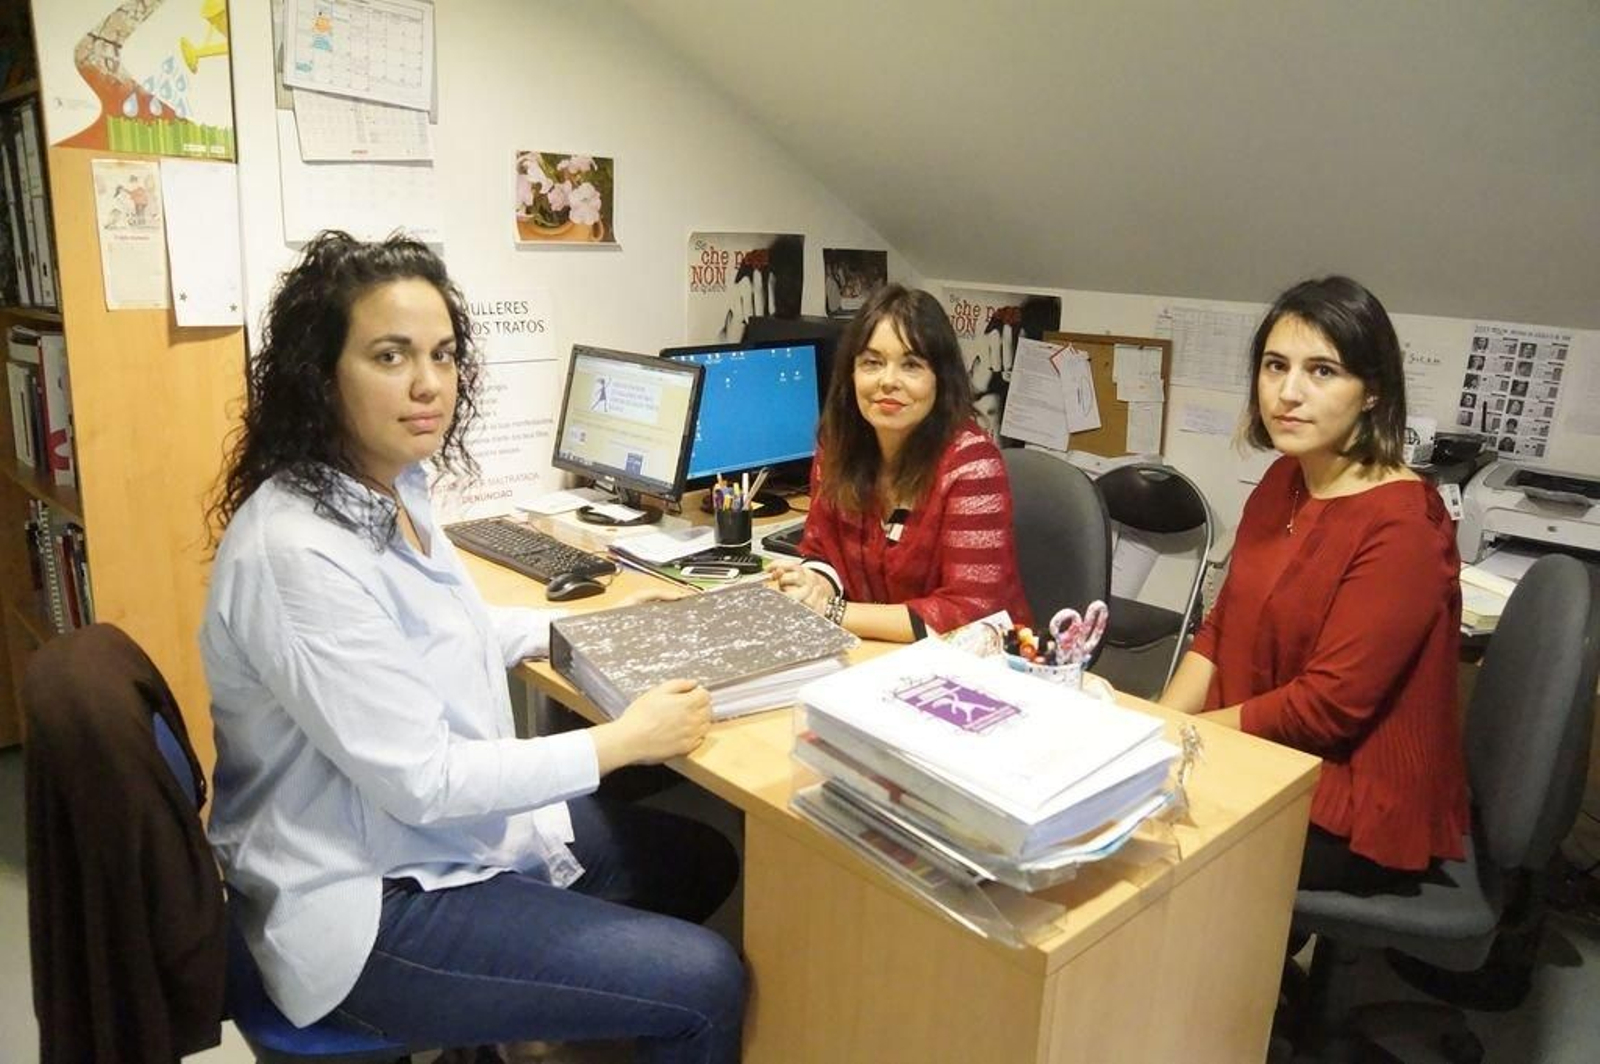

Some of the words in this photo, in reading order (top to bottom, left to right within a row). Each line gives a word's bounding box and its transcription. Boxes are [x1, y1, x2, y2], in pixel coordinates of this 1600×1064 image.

[701, 245, 729, 265] che
[691, 265, 727, 285] NON
[955, 299, 981, 317] che
[494, 319, 546, 335] TRATOS
[951, 314, 978, 335] ON
